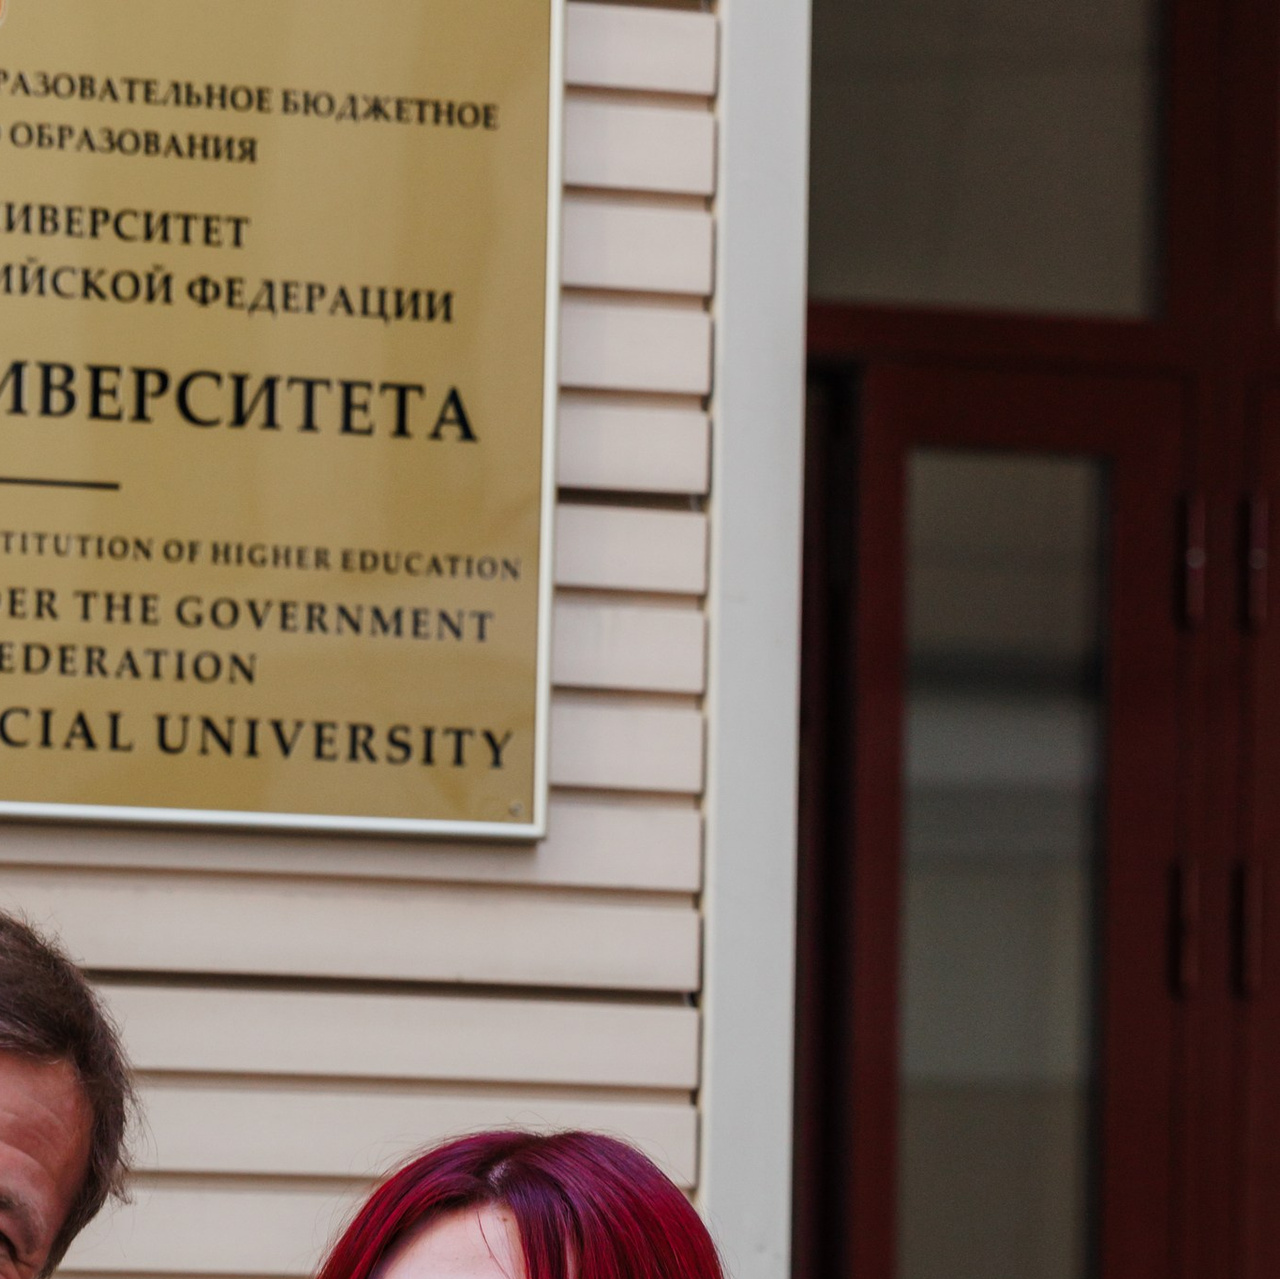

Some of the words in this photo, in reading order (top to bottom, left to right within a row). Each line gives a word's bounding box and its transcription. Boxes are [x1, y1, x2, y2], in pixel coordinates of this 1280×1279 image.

[281, 89, 499, 131] БЮДЖЕТНОЕ
[8, 122, 259, 164] ОБРАЗОВАНИЯ
[185, 275, 455, 324] ФЕДЕРАЦИИ
[161, 540, 204, 564] OF
[210, 542, 332, 571] HIGHER
[340, 549, 521, 580] EDUCATION
[73, 591, 160, 626] THE
[174, 596, 493, 643] GOVERNMENT
[155, 714, 513, 769] UNIVERSITY
